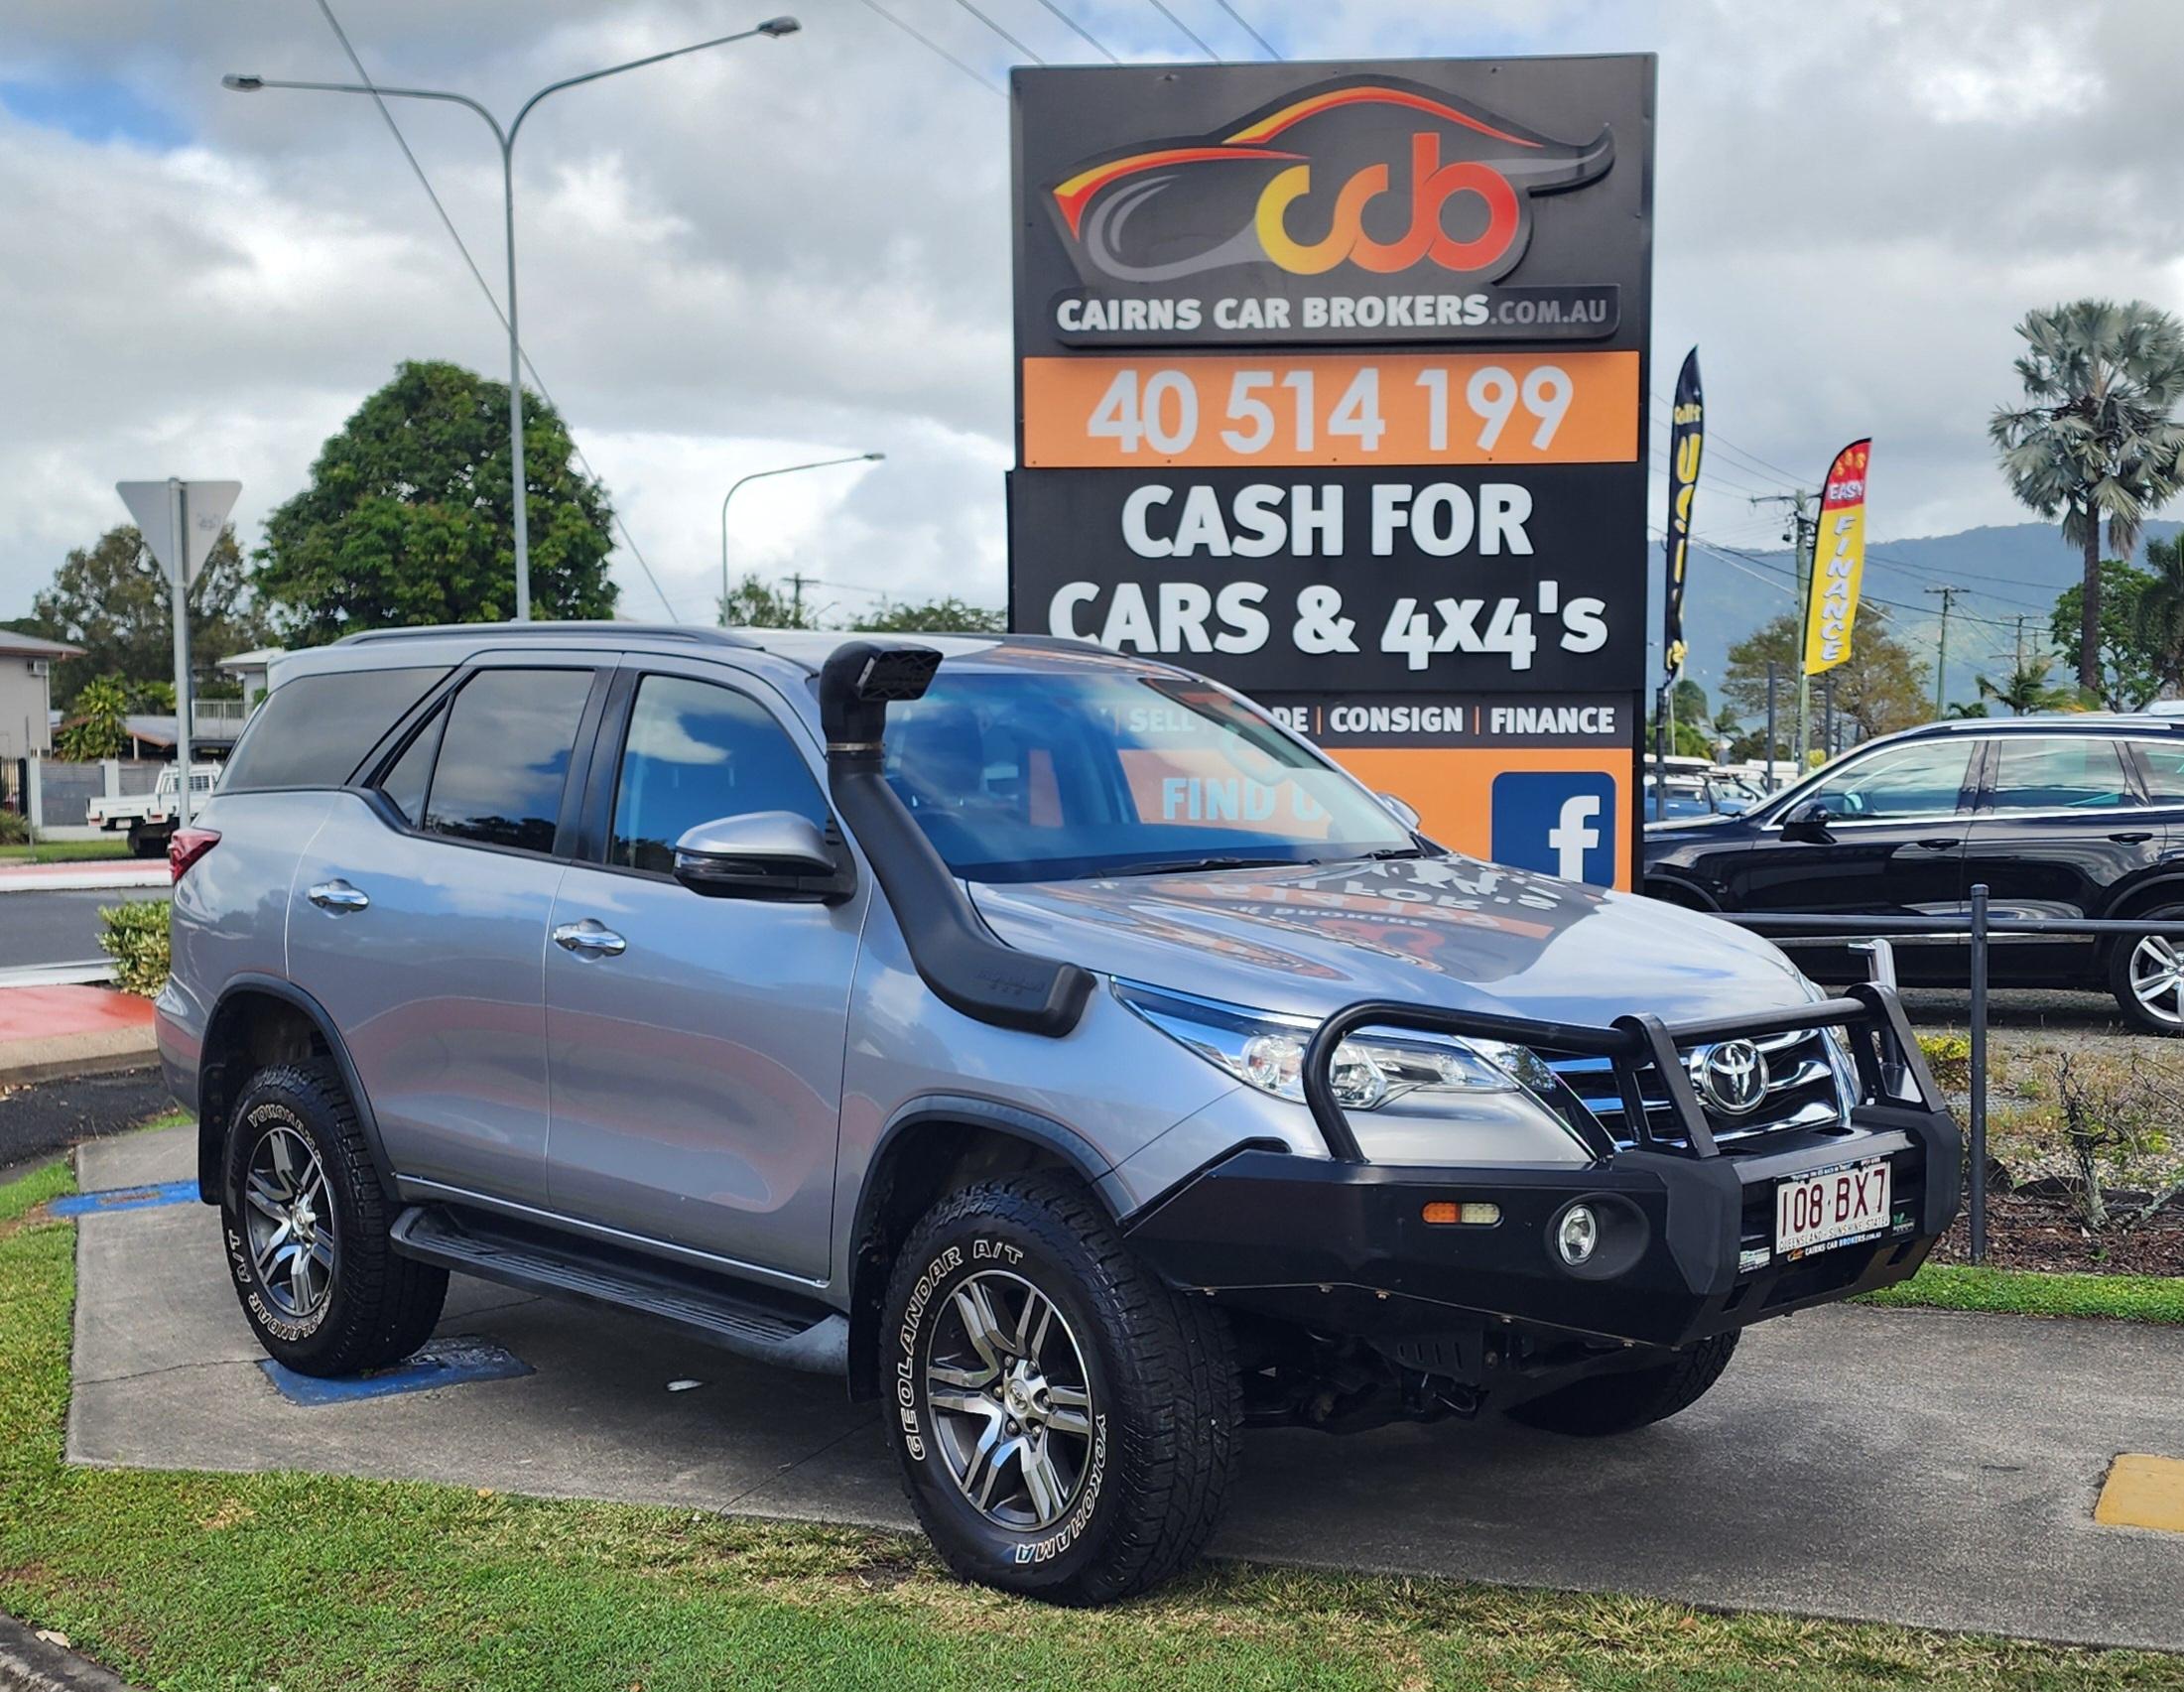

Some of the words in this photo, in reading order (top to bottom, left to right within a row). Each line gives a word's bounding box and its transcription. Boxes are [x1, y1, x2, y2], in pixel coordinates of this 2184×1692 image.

[1056, 297, 1202, 332] CAIRNS
[1214, 296, 1291, 329] CAR
[1087, 369, 1199, 455] 40
[1220, 368, 1385, 454] 514
[1415, 365, 1574, 451] 199
[1121, 483, 1345, 558] CASH
[1371, 482, 1534, 557] FOR
[1828, 480, 1863, 501] EASY
[1048, 581, 1271, 655] CARS
[1292, 585, 1360, 654] &
[1821, 515, 1857, 662] FINANCE
[1128, 707, 1197, 733] SELL
[1330, 706, 1465, 733] CONSIGN
[1489, 707, 1615, 734] FINANCE
[1162, 777, 1277, 822] FIND
[247, 1103, 322, 1166] YOKOHAMA
[1782, 1182, 1824, 1238] 108
[1835, 1168, 1885, 1224] BX7
[226, 1229, 252, 1284] A/T
[1778, 1230, 1822, 1251] QUEENSLAND
[1828, 1220, 1863, 1238] SUNSHINE
[1865, 1215, 1887, 1230] STATE
[1805, 1242, 1826, 1255] CAIRNS
[1827, 1239, 1839, 1249] CAR
[247, 1289, 333, 1343] OLANDAR
[896, 1245, 963, 1462] GEOLANDAR
[972, 1238, 1024, 1266] A/T
[1014, 1414, 1108, 1565] YOKOHAMA
